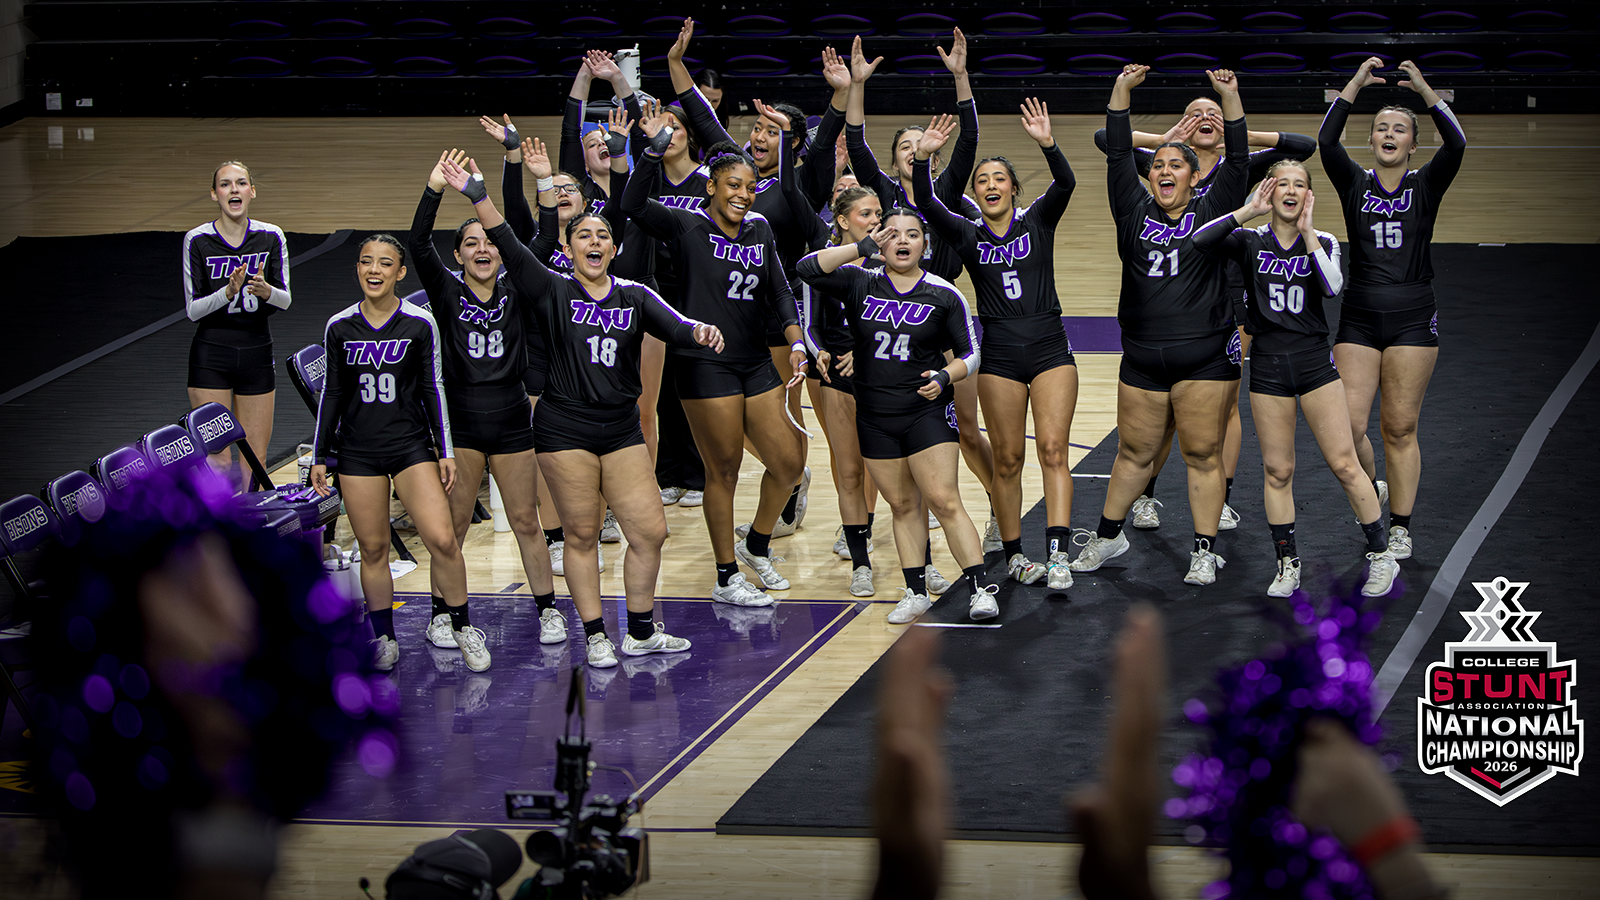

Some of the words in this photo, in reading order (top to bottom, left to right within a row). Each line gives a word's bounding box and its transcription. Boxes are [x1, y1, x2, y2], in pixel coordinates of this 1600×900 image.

[1361, 188, 1414, 218] TNU
[1139, 212, 1196, 246] TNU
[1370, 221, 1403, 249] 15
[206, 251, 270, 279] TNU
[709, 233, 765, 270] TNU
[977, 232, 1031, 267] TNU
[1147, 248, 1180, 277] 21
[1256, 250, 1313, 281] TNU
[727, 270, 760, 300] 22
[1001, 270, 1023, 300] 5
[1268, 283, 1305, 315] 50
[458, 295, 508, 329] TNU
[570, 299, 634, 333] TNU
[861, 295, 936, 329] TNU
[343, 339, 412, 369] TNU
[467, 329, 505, 359] 98
[586, 334, 619, 368] 18
[874, 330, 911, 361] 24
[359, 372, 396, 403] 39
[197, 412, 235, 443] BISONS
[155, 435, 195, 466] BISONS
[60, 482, 100, 516] BISONS
[3, 505, 49, 541] BISONS
